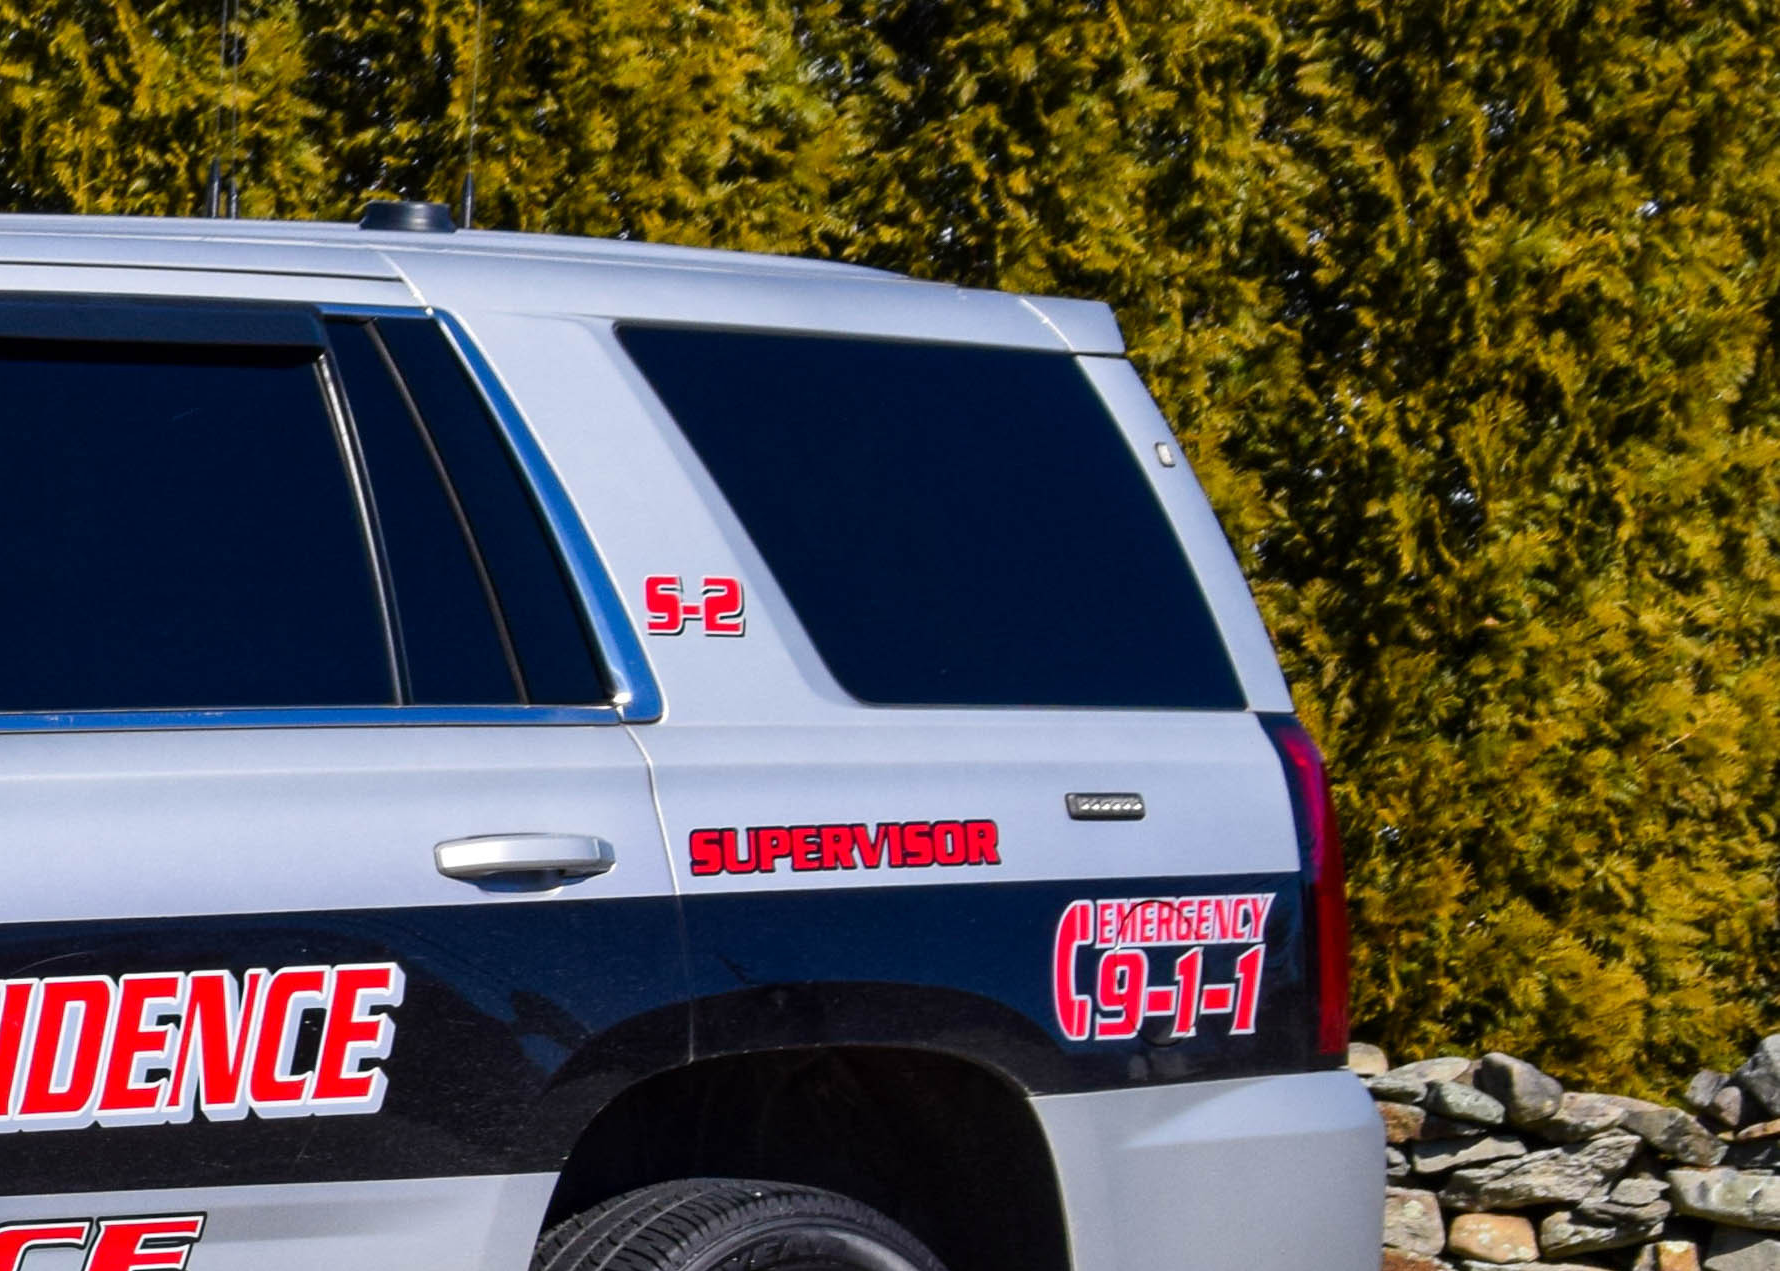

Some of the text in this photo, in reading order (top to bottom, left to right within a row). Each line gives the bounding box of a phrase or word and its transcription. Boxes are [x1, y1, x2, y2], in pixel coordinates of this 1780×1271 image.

[644, 574, 746, 638] S-2
[688, 819, 1002, 876] SUPERVISOR
[1094, 892, 1277, 949] EMERGENCY
[1094, 943, 1266, 1041] 9-1-1
